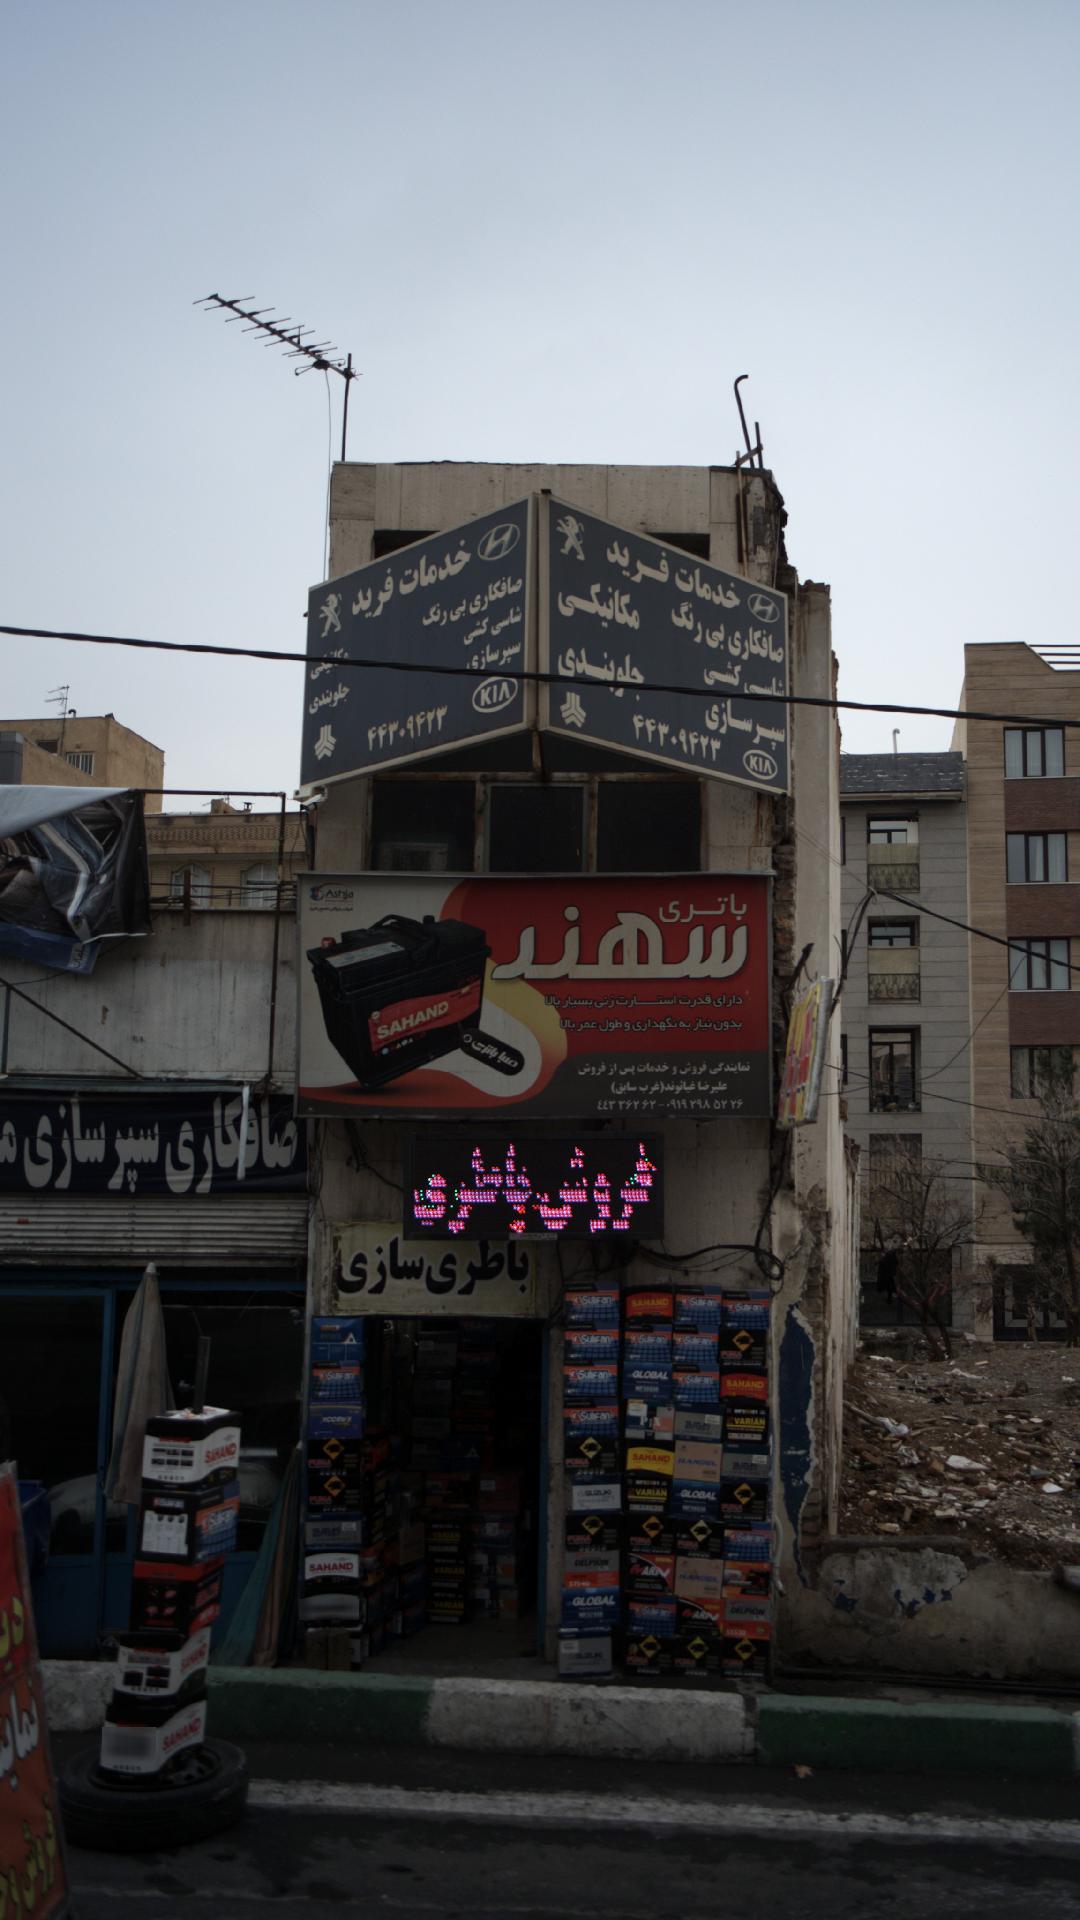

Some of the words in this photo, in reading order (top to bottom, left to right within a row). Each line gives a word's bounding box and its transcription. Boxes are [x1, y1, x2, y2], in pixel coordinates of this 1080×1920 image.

[399, 539, 471, 595] خدمات
[606, 541, 669, 583] فرید
[351, 567, 393, 618] فرید
[469, 576, 523, 615] صافکاری
[674, 567, 741, 608] خدمات
[421, 603, 447, 627] رنگ
[449, 599, 467, 622] بی
[557, 583, 640, 630] مکانیکی
[491, 606, 522, 636] شاسی
[671, 601, 703, 642] رنگ
[463, 618, 488, 645] کشی
[705, 623, 725, 649] بی
[728, 626, 784, 663] صافکاری
[557, 648, 645, 701] جلوبندی
[703, 661, 741, 685] کشی
[480, 684, 511, 707] KIA
[744, 676, 784, 697] شاسی
[308, 682, 350, 715] جلوبندی
[367, 704, 448, 751] ۴۴۳۰۹۴۲۳
[632, 712, 721, 762] ۴۴۳۰۹۴۲۳
[751, 754, 773, 775] KIA
[658, 893, 748, 923] باتری
[491, 906, 748, 980] سهند
[544, 995, 561, 1006] بالا
[564, 995, 593, 1009] بسیار
[594, 994, 615, 1009] زنی
[679, 993, 712, 1008] قدرت
[714, 994, 743, 1008] دارای
[376, 1000, 449, 1040] SAHAND
[559, 1019, 576, 1030] بالا
[578, 1020, 598, 1031] عمر
[599, 1018, 623, 1031] طول
[631, 1017, 677, 1031] نگهداری
[679, 1020, 691, 1030] به
[695, 1017, 716, 1031] نیاز
[717, 1019, 743, 1031] بدون
[577, 1062, 607, 1075] فروش
[607, 1063, 617, 1075] از
[619, 1065, 636, 1076] پس
[636, 1062, 669, 1073] خدمات
[679, 1062, 707, 1075] فروش
[709, 1062, 751, 1075] نمایندگی
[698, 1081, 728, 1094] علیرضا
[165, 1096, 298, 1193] صافکاری
[631, 1370, 669, 1380] GLOBAL
[726, 1380, 765, 1390] SAHAND
[734, 1415, 766, 1426] VARIAN
[205, 1442, 238, 1464] SAHAND
[632, 1453, 671, 1463] SAHAND
[634, 1487, 668, 1497] VARIAN
[680, 1489, 717, 1501] GLOBAL
[309, 1561, 354, 1573] SAHAND
[572, 1595, 616, 1607] GLOBAL
[162, 1717, 202, 1750] SAHAND
